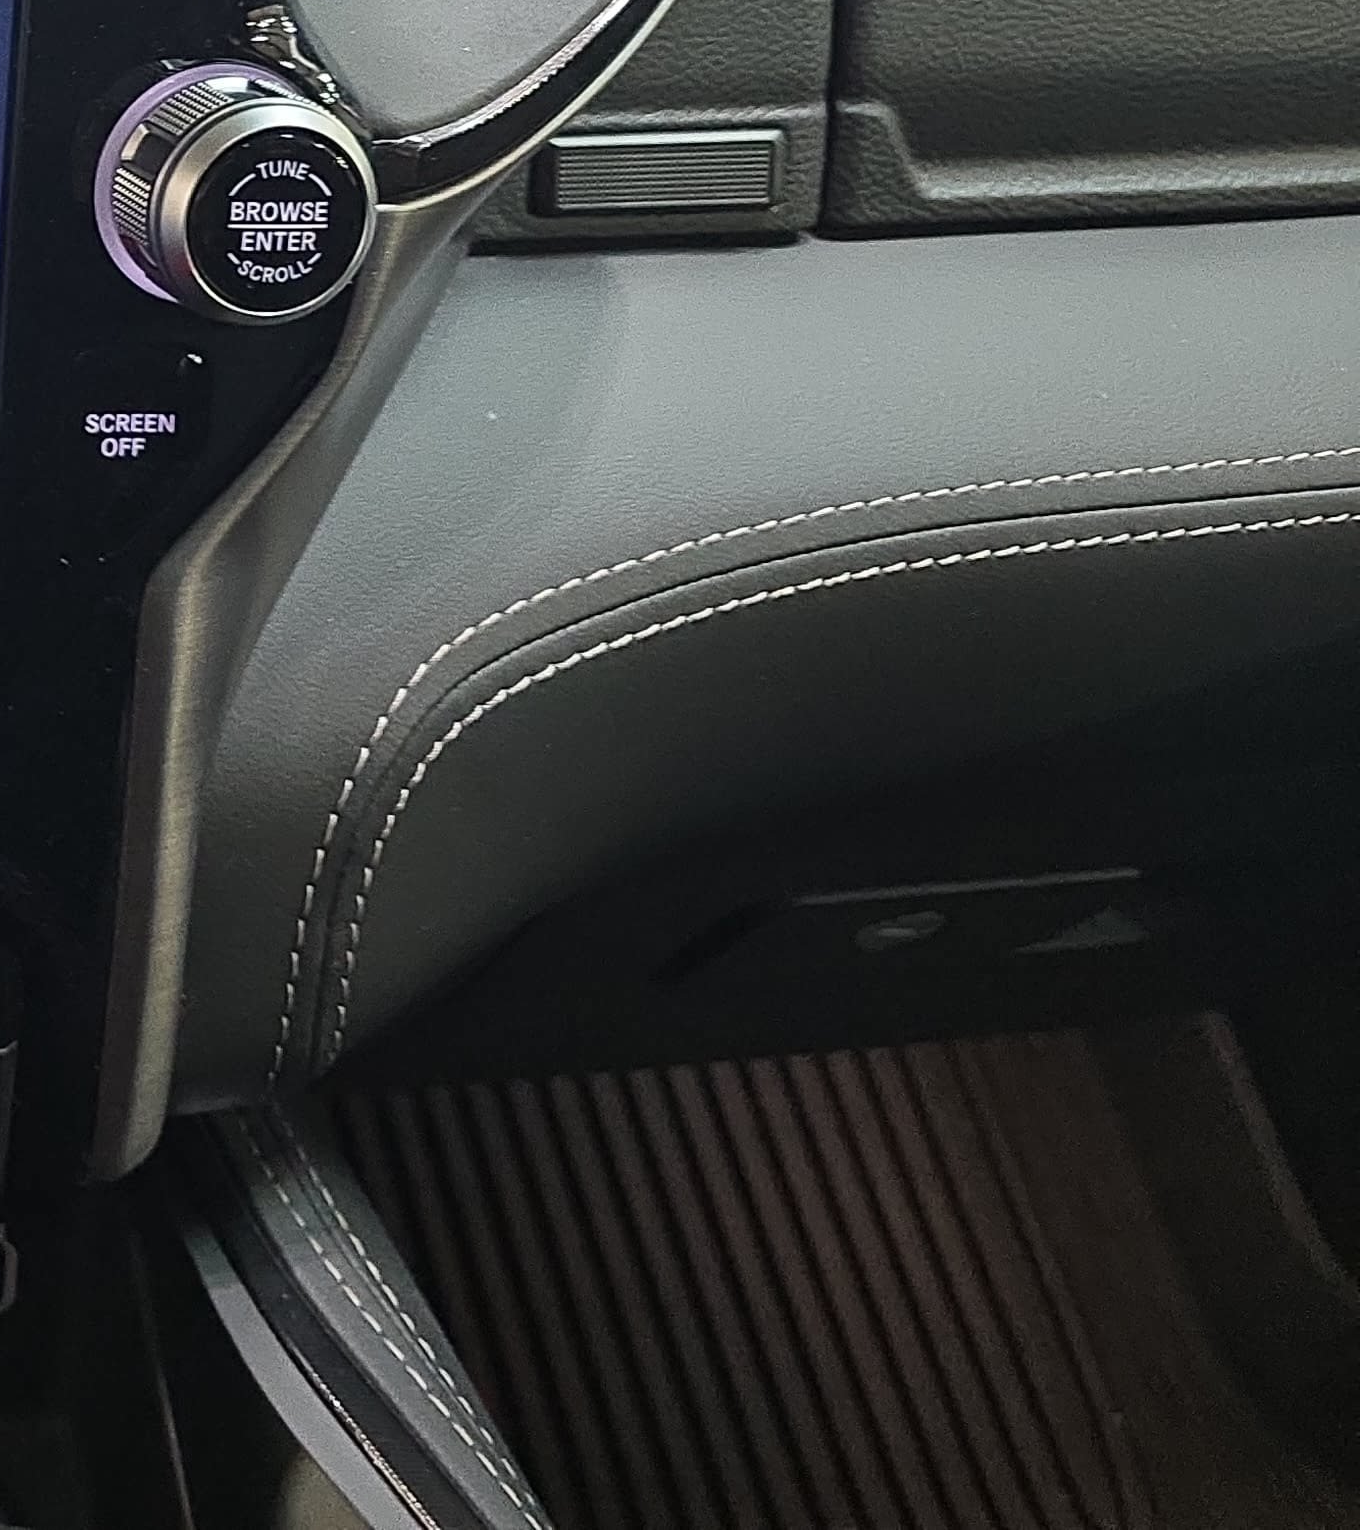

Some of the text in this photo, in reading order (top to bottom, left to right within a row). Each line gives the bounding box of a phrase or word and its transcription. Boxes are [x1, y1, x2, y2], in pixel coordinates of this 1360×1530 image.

[257, 161, 312, 181] TUNE
[230, 200, 330, 223] BROWSE
[240, 231, 317, 253] ENTER
[237, 259, 313, 284] SCROLL
[85, 413, 176, 433] SCREEN
[101, 437, 147, 457] OFF
